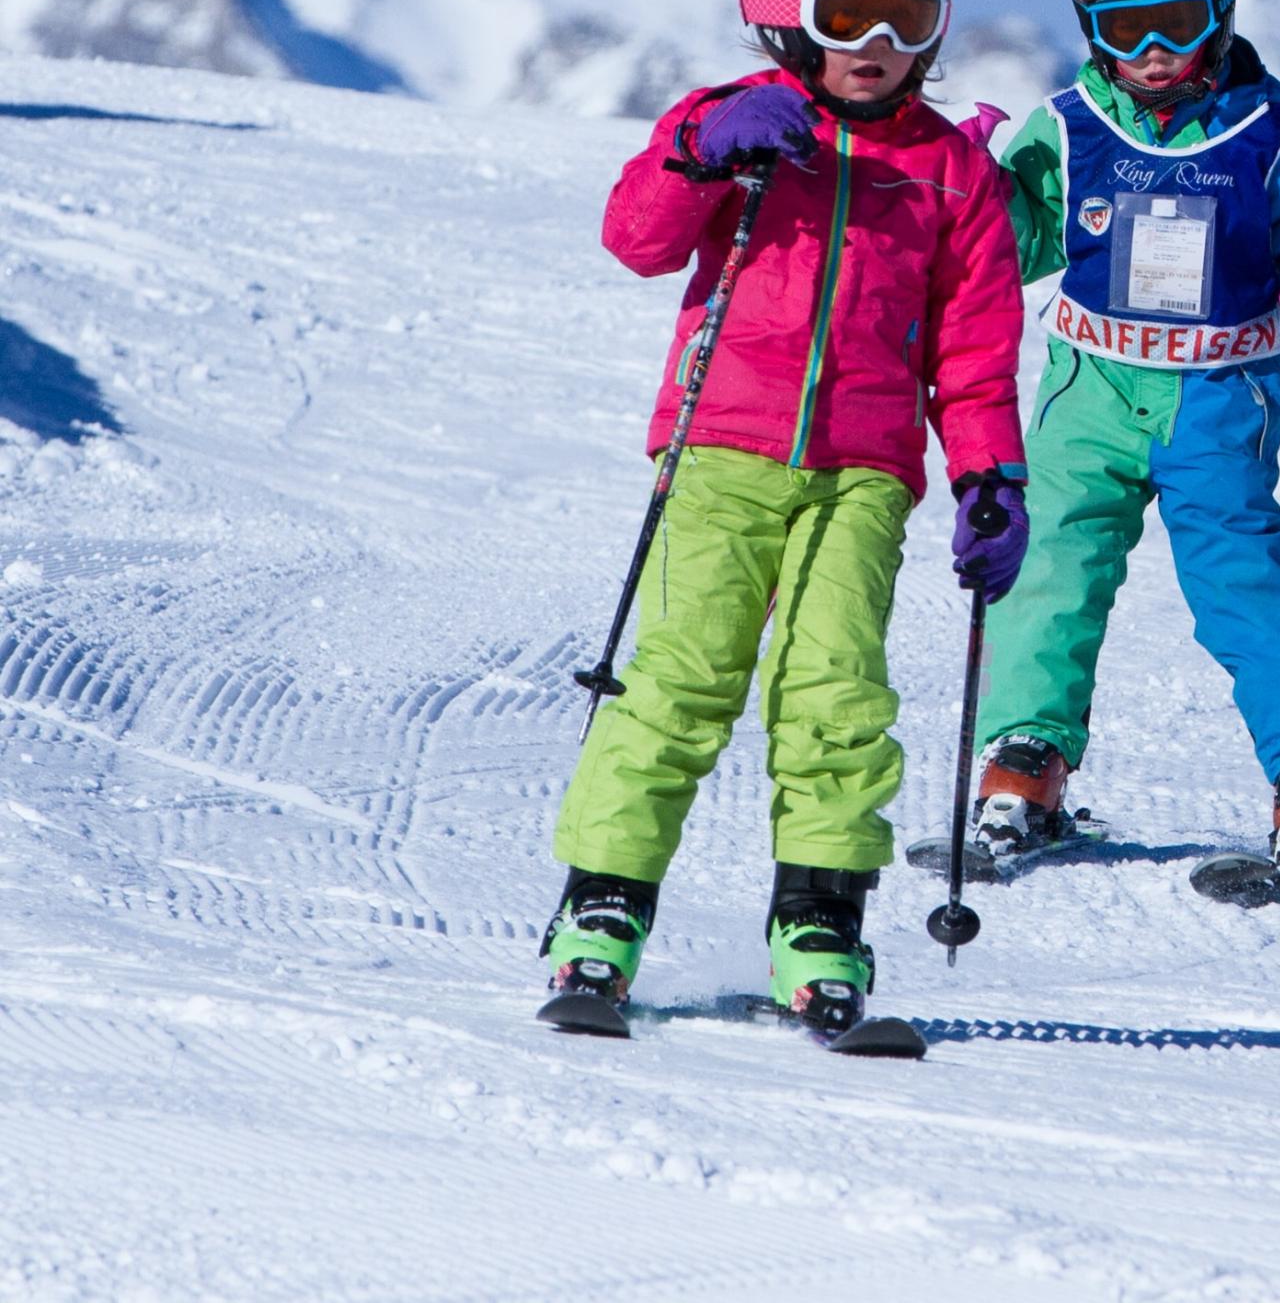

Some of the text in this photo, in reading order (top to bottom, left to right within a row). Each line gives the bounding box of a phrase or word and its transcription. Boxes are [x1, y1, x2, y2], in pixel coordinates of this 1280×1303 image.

[1107, 160, 1155, 192] King
[1176, 161, 1235, 192] Queen
[1056, 299, 1276, 363] RAIFFEISEN
